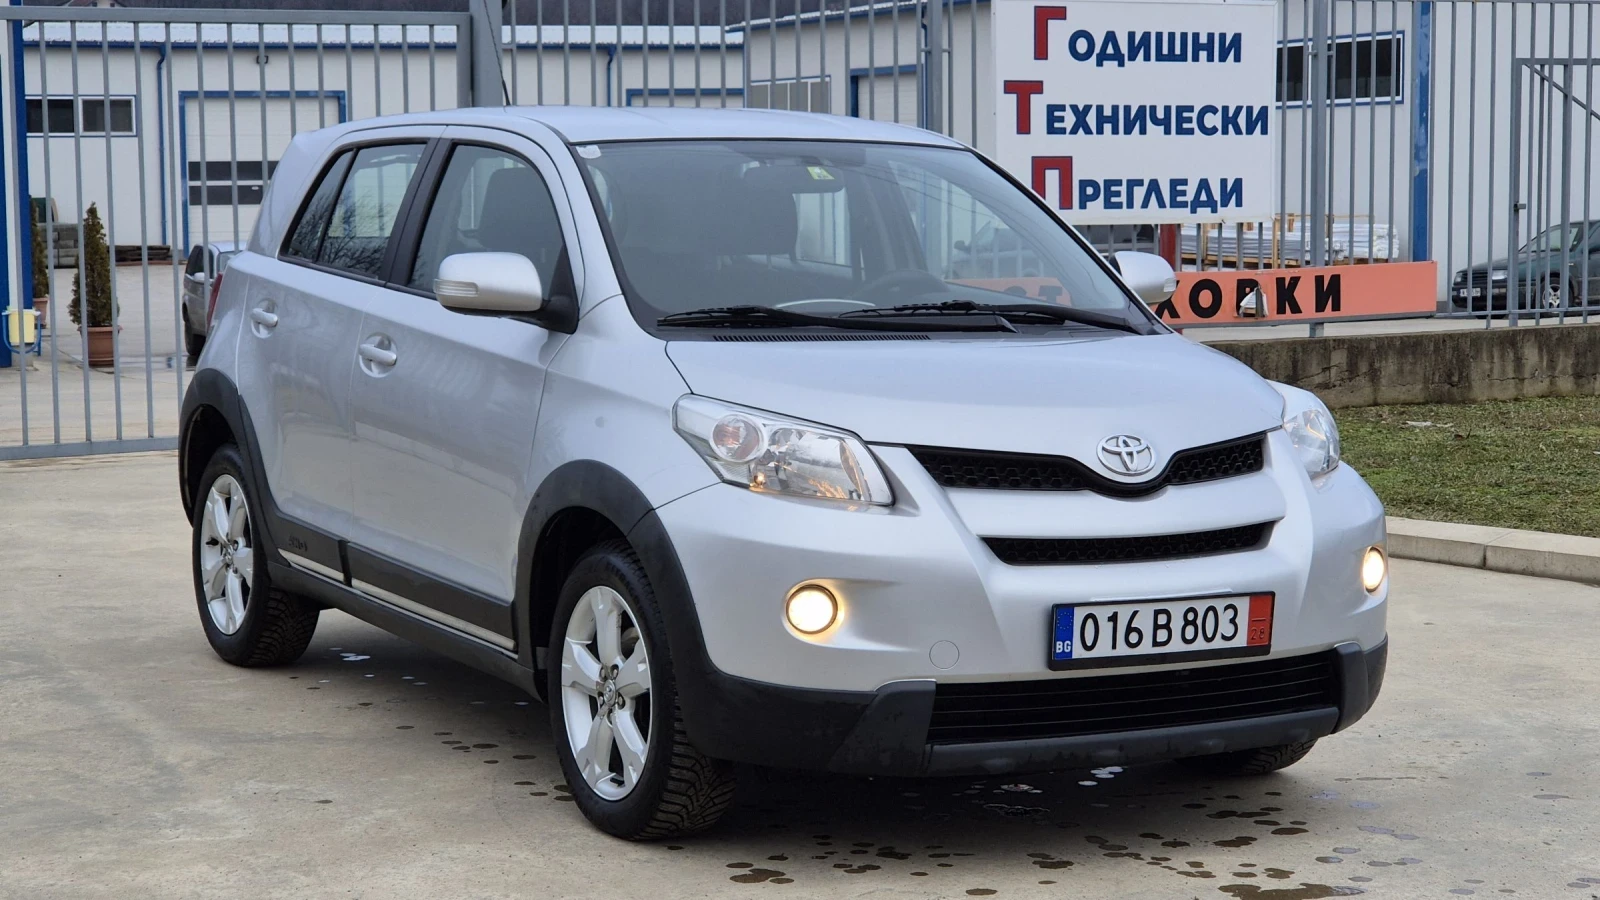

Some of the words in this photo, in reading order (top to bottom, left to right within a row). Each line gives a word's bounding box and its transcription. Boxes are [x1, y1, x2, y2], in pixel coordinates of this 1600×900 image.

[1034, 6, 1242, 67] ГОДИШНИ
[1003, 80, 1269, 136] ТЕХНИЧЕСКИ
[1031, 156, 1243, 214] ПРЕГЛЕДИ
[1055, 641, 1071, 653] BG
